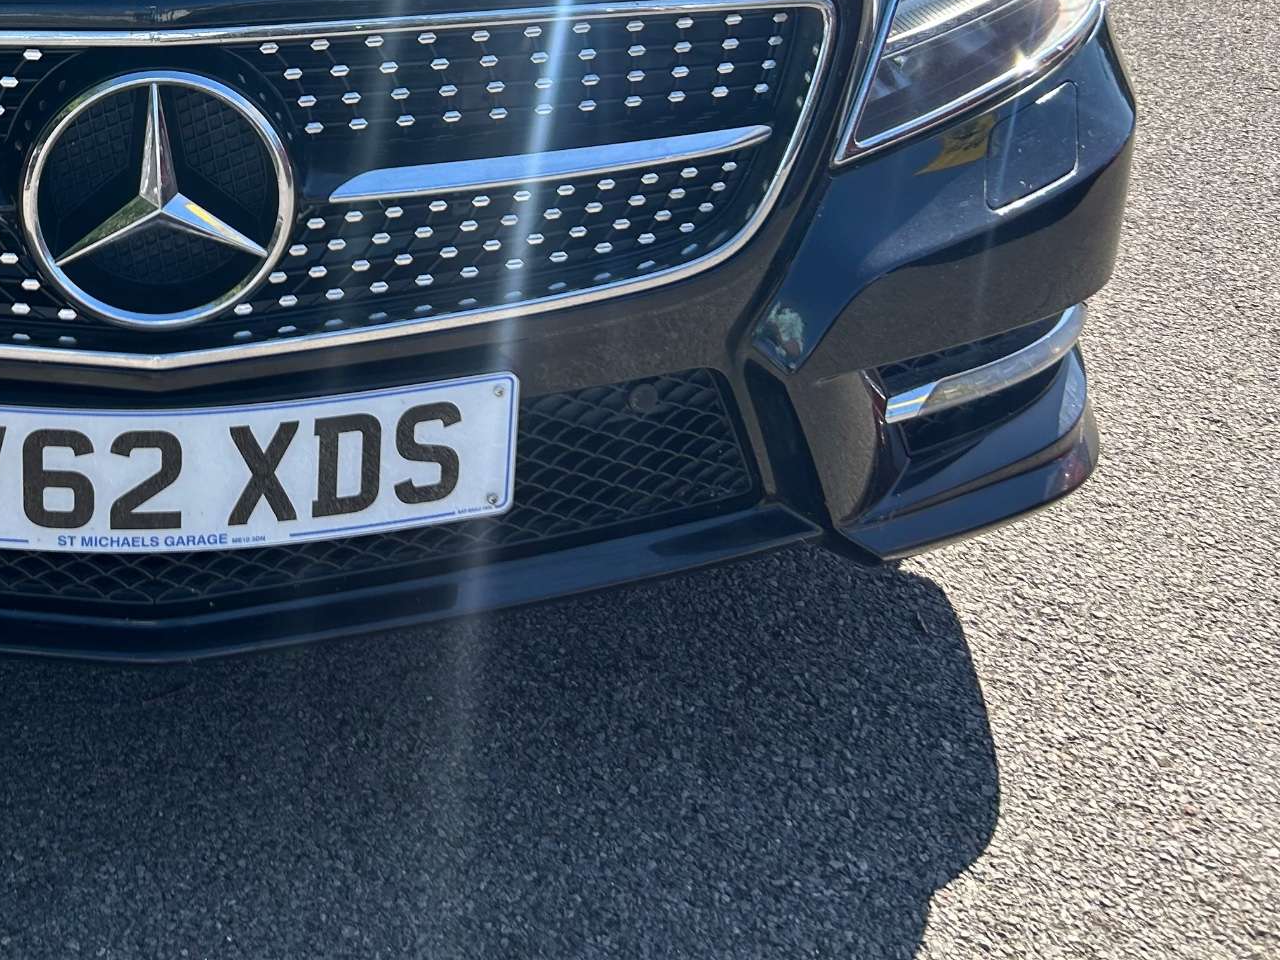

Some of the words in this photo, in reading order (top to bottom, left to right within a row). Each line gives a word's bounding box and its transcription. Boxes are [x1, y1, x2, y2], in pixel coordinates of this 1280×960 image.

[228, 401, 462, 526] XDS
[58, 535, 76, 546] ST
[81, 536, 160, 547] MICHAELS
[164, 534, 228, 547] GARAGE
